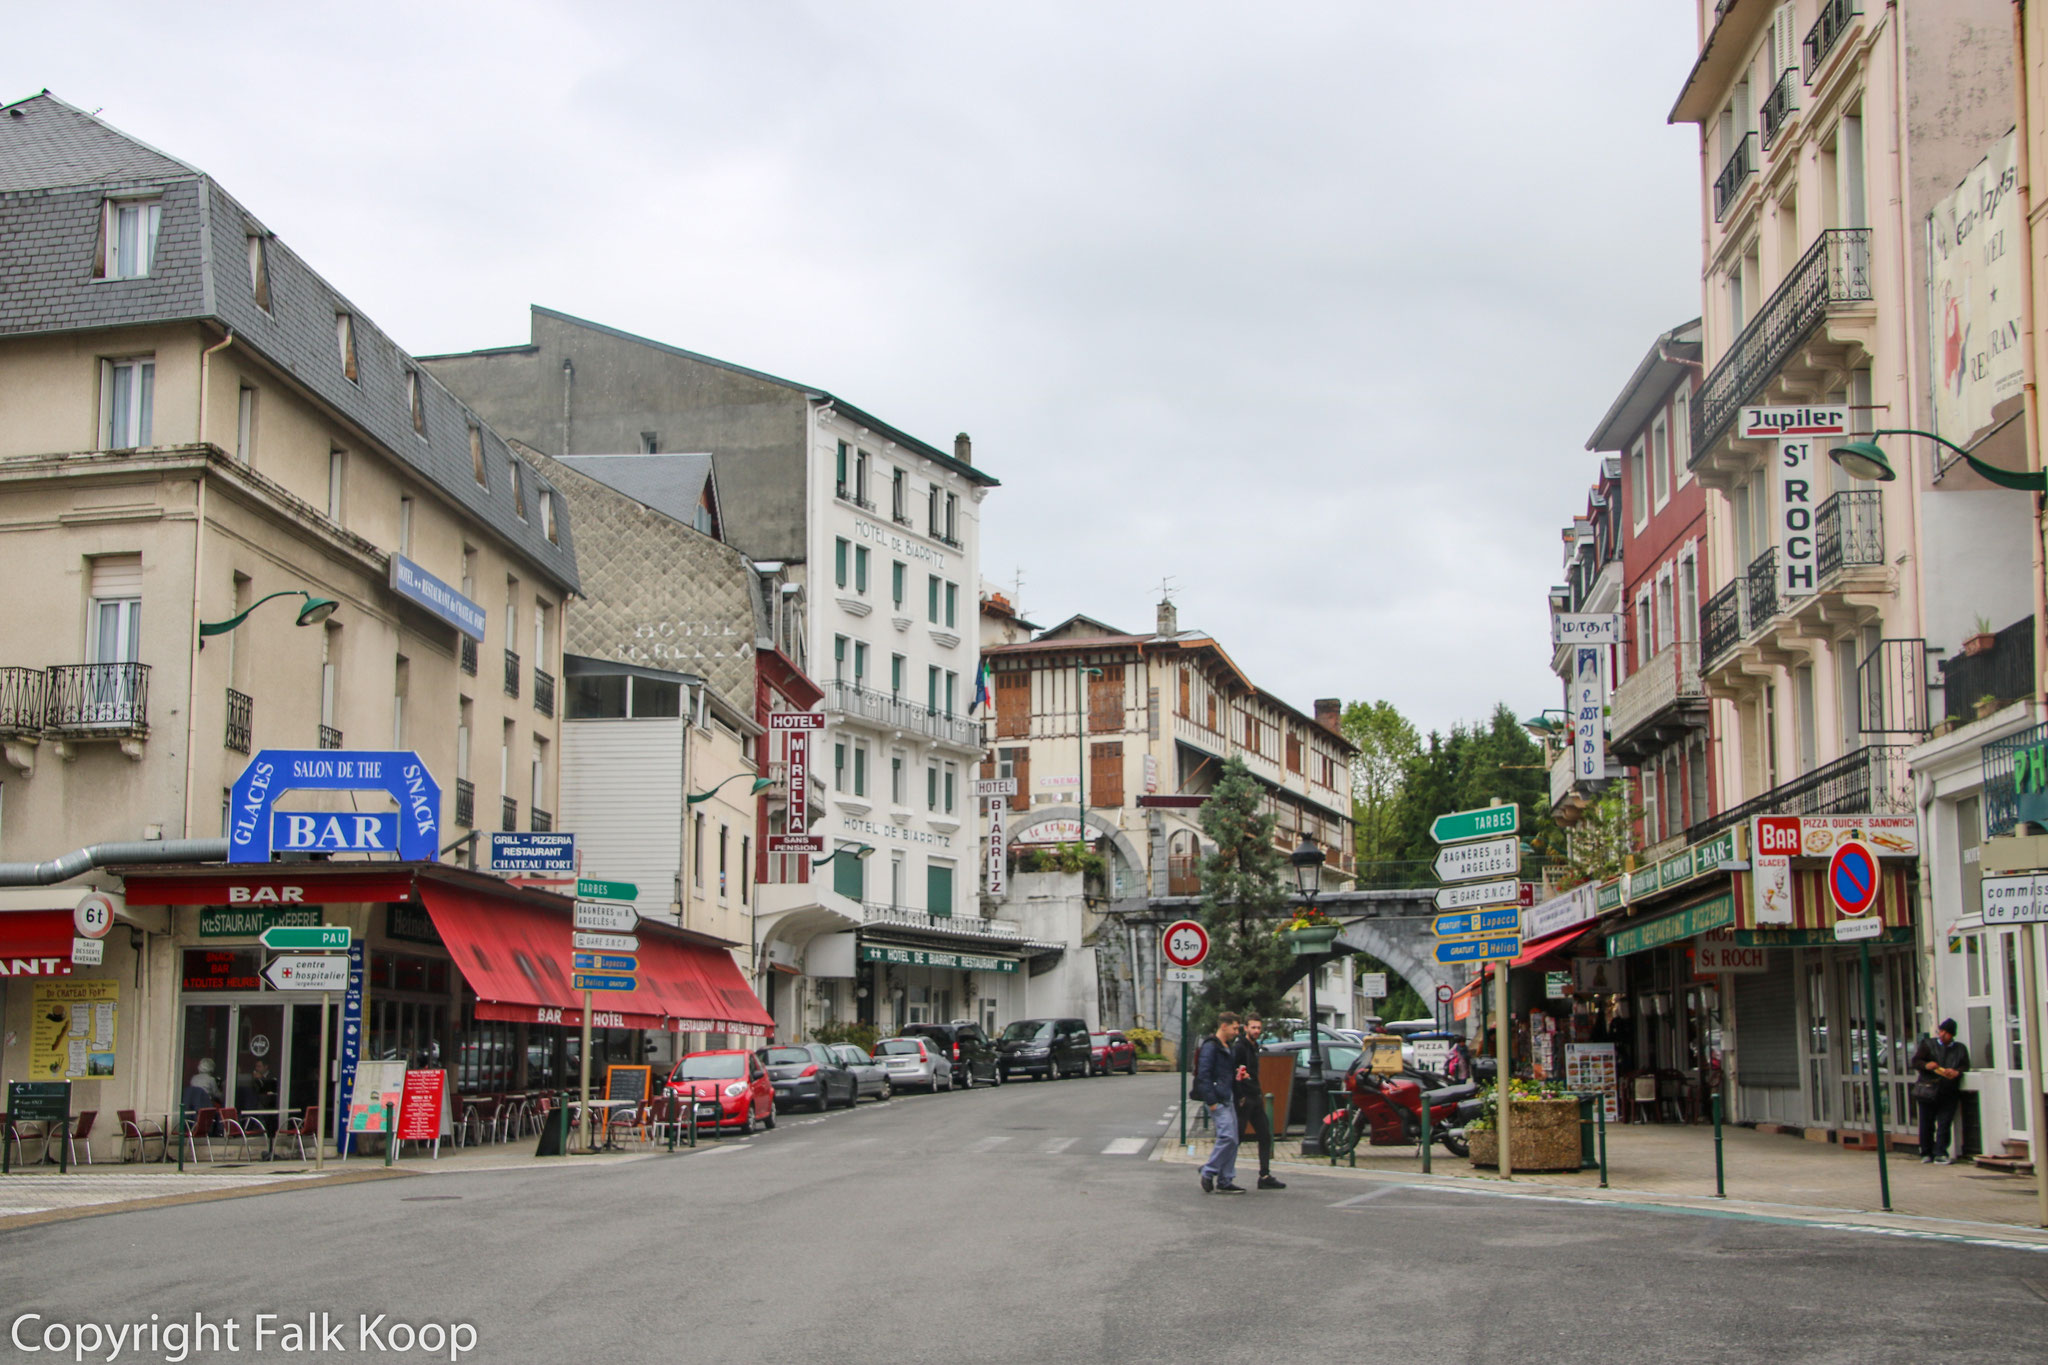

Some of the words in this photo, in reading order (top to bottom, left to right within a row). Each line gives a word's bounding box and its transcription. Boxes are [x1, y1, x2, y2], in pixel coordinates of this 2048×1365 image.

[1748, 408, 1843, 432] Jupiler
[1783, 444, 1809, 468] ST
[1785, 479, 1813, 589] ROCH
[855, 518, 888, 547] HOTEL
[891, 536, 902, 553] DE
[905, 540, 945, 569] BIARRITZ
[1562, 621, 1612, 639] மாதா
[773, 715, 817, 728] HOTEL
[293, 760, 334, 778] SALON
[337, 761, 354, 779] DE
[357, 761, 383, 779] THE
[791, 738, 804, 830] MIRELLA
[979, 781, 1010, 793] HOTEL
[234, 761, 275, 846] GLACES
[402, 764, 437, 837] SNACK
[1474, 812, 1513, 830] TARBES
[1803, 818, 1829, 828] PIZZA
[1832, 818, 1864, 828] QUICHE
[1868, 818, 1915, 828] SANDWICH
[284, 815, 385, 849] BAR
[844, 817, 879, 835] HOTEL
[884, 825, 897, 838] DE
[902, 829, 951, 848] BIARRITZ
[1762, 824, 1798, 850] BAR
[494, 835, 521, 845] GRILL
[531, 835, 573, 845] PIZZERIA
[783, 836, 810, 844] SANS
[991, 800, 1002, 893] BIARRITZ
[503, 847, 563, 857] RESTAURANT
[774, 844, 818, 852] PENSION
[492, 859, 542, 870] CHATEAU
[545, 859, 573, 870] FORT
[1758, 858, 1787, 868] GLACES
[229, 886, 305, 903] BAR
[579, 882, 608, 895] TARBES
[1460, 888, 1481, 902] GARE
[1988, 903, 2005, 917] de
[201, 913, 264, 933] RESTAURANT
[1482, 914, 1516, 928] Lapacca
[322, 932, 345, 944] PAU
[586, 936, 603, 946] GARE
[1753, 931, 1790, 945] BAR
[75, 947, 101, 956] DESSERTE
[1489, 942, 1516, 954] Hélios
[206, 952, 235, 962] SNACK
[887, 950, 910, 963] HOTEL
[914, 952, 925, 964] DE
[928, 953, 957, 967] BIARRITZ
[960, 955, 999, 970] RESTAURANT
[1701, 950, 1717, 967] St
[1721, 950, 1763, 967] ROCH
[211, 964, 230, 974] BAR
[296, 960, 326, 969] centre
[295, 970, 346, 980] hospitalier
[189, 978, 224, 988] TOUTES
[226, 978, 261, 988] HEURES
[537, 1007, 562, 1024] BAR
[593, 1013, 625, 1028] HOTEL
[716, 1020, 726, 1033] DU
